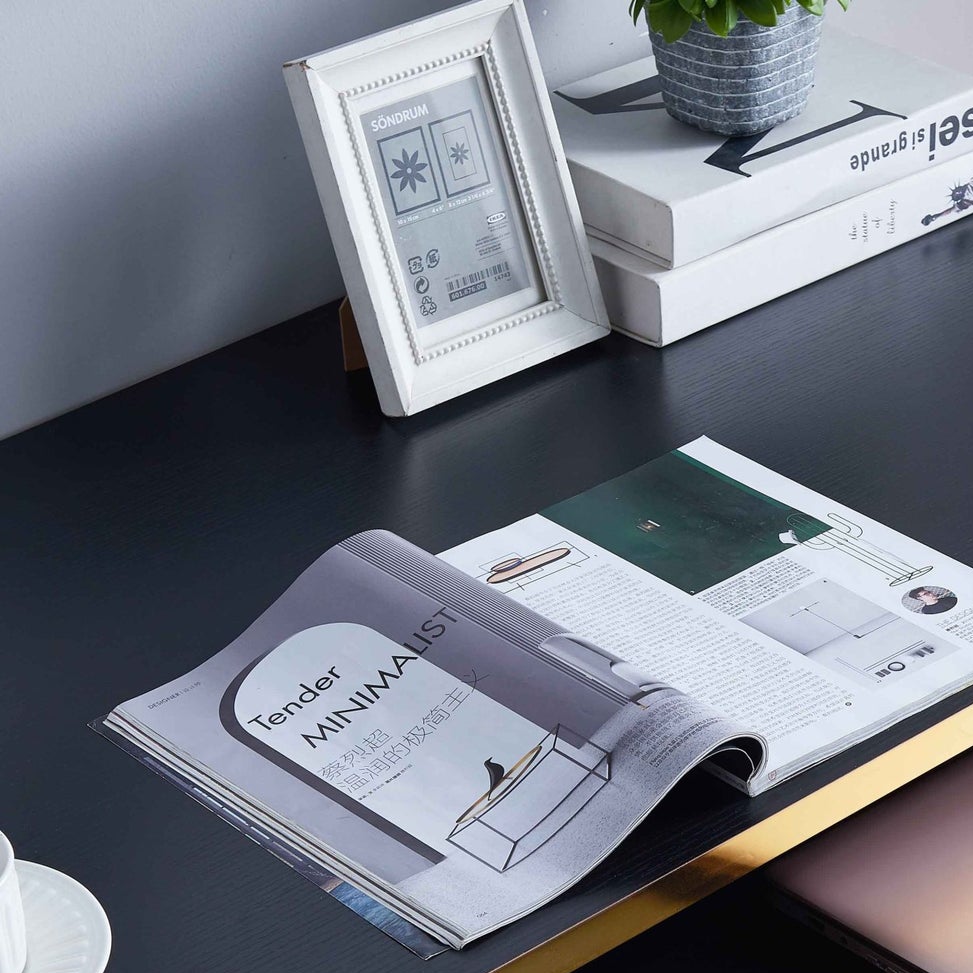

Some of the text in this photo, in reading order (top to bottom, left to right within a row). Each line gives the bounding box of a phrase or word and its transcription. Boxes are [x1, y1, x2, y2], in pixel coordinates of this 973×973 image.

[371, 103, 429, 132] SÖNDRUM
[850, 130, 908, 171] grande
[247, 665, 341, 731] Tender
[300, 606, 458, 749] MINIMALIST
[318, 728, 394, 781] 蔡烈超
[336, 668, 491, 794] 温润的极简主义
